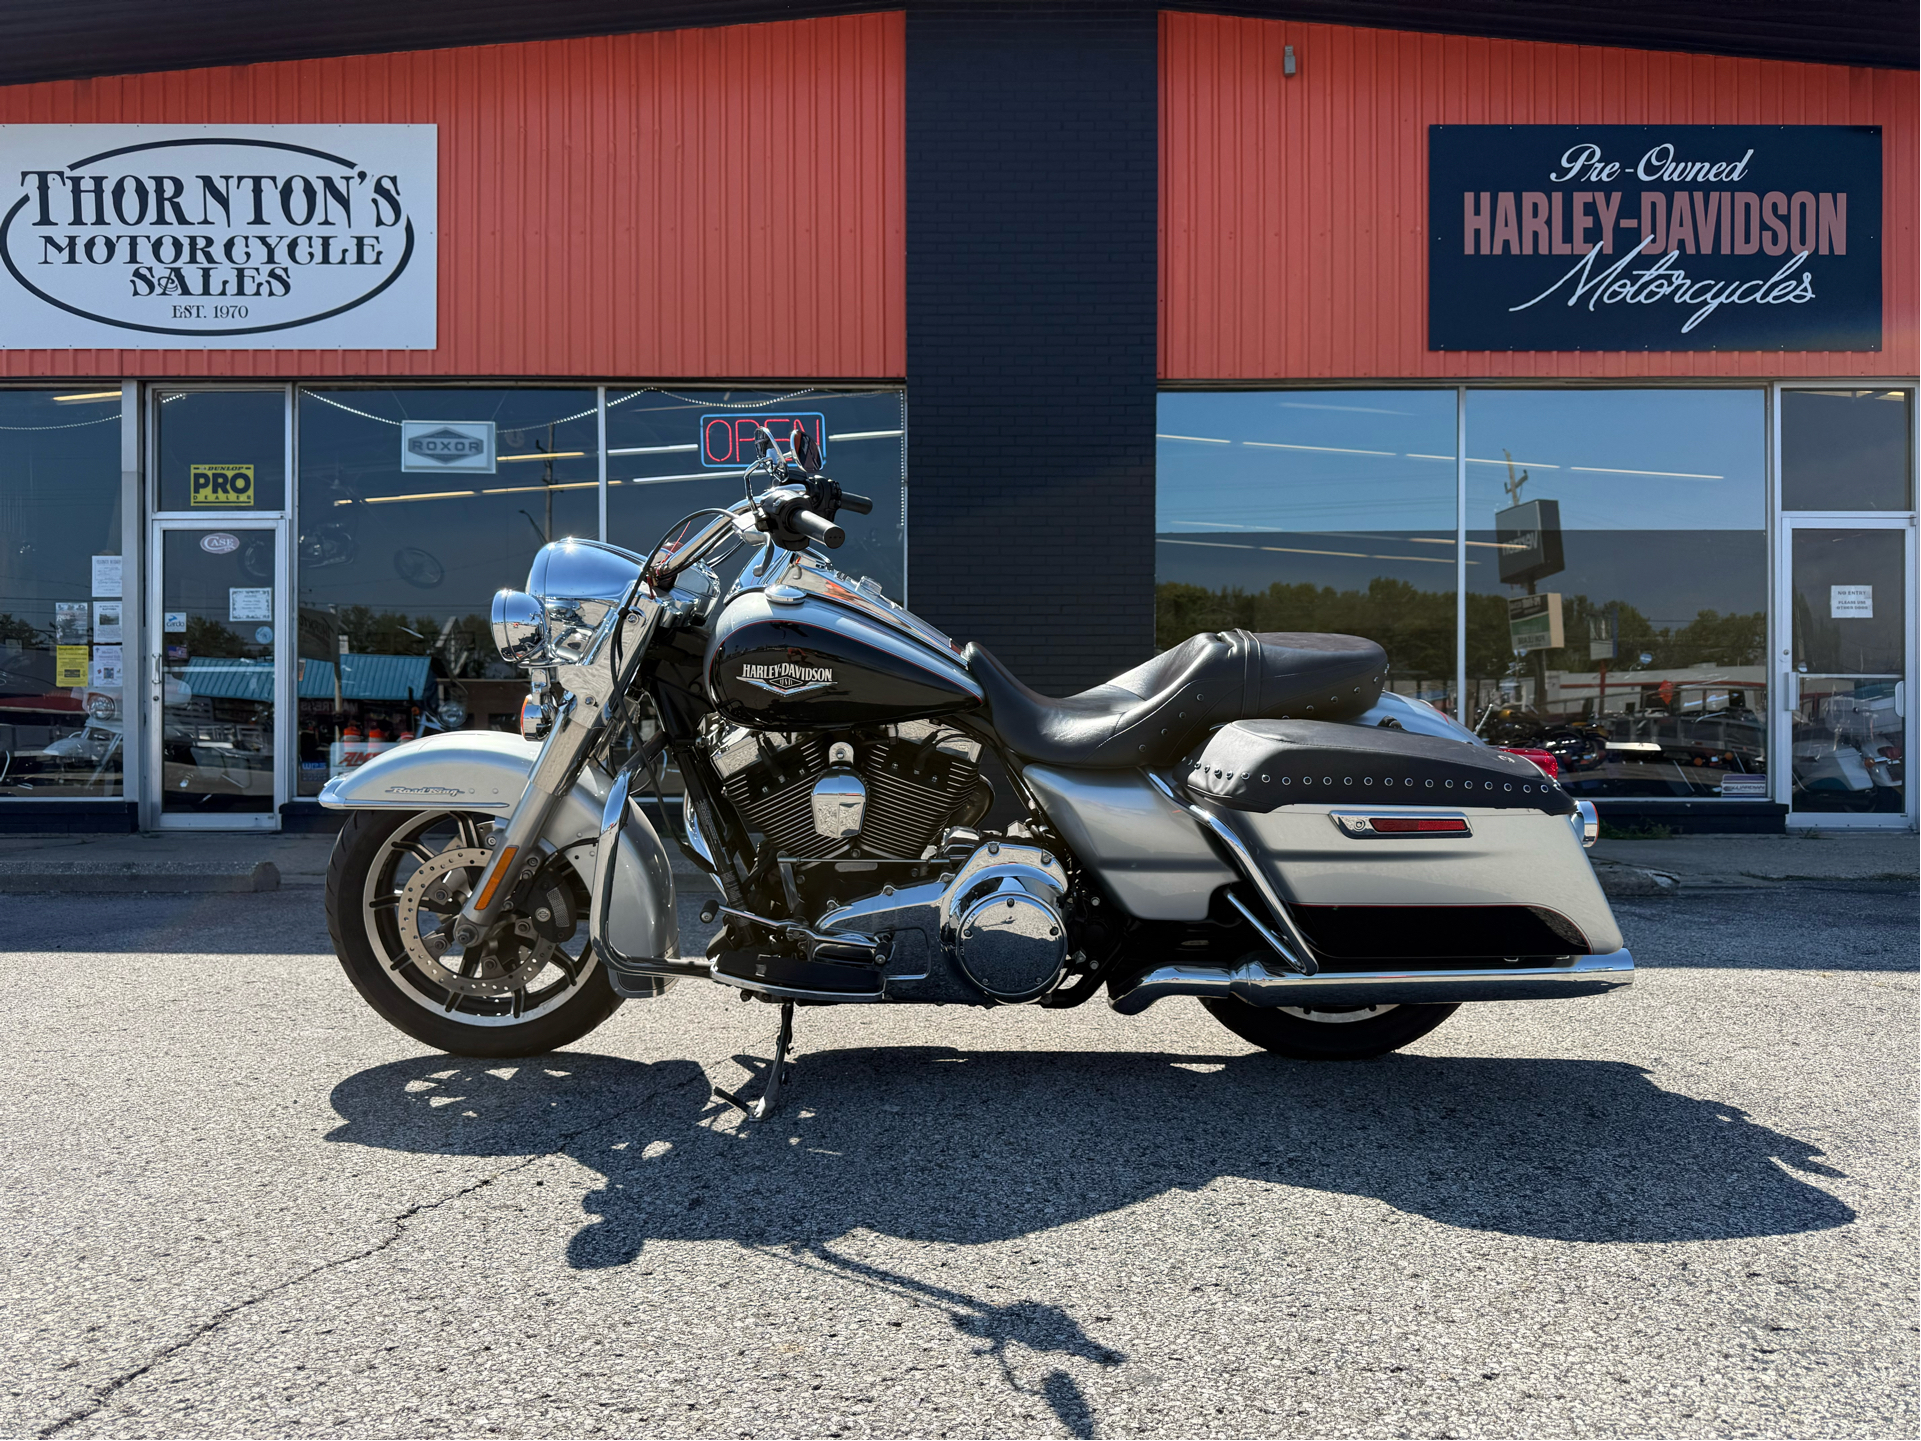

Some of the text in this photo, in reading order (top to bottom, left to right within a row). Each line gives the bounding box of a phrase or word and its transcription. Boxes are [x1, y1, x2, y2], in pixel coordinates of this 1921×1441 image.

[1550, 143, 1754, 182] Pre-Owned
[20, 171, 401, 228] THORNTON'S
[1463, 191, 1847, 256] HARLEY-DAVIDSON
[37, 235, 384, 265] MOTORCYCLE
[130, 267, 291, 297] SALES
[1508, 234, 1816, 334] Motorcycles
[171, 305, 249, 319] EST. 1970
[412, 441, 480, 452] ROXOR
[193, 472, 251, 494] PRO
[742, 663, 833, 682] HARLEY-DAVIDSON
